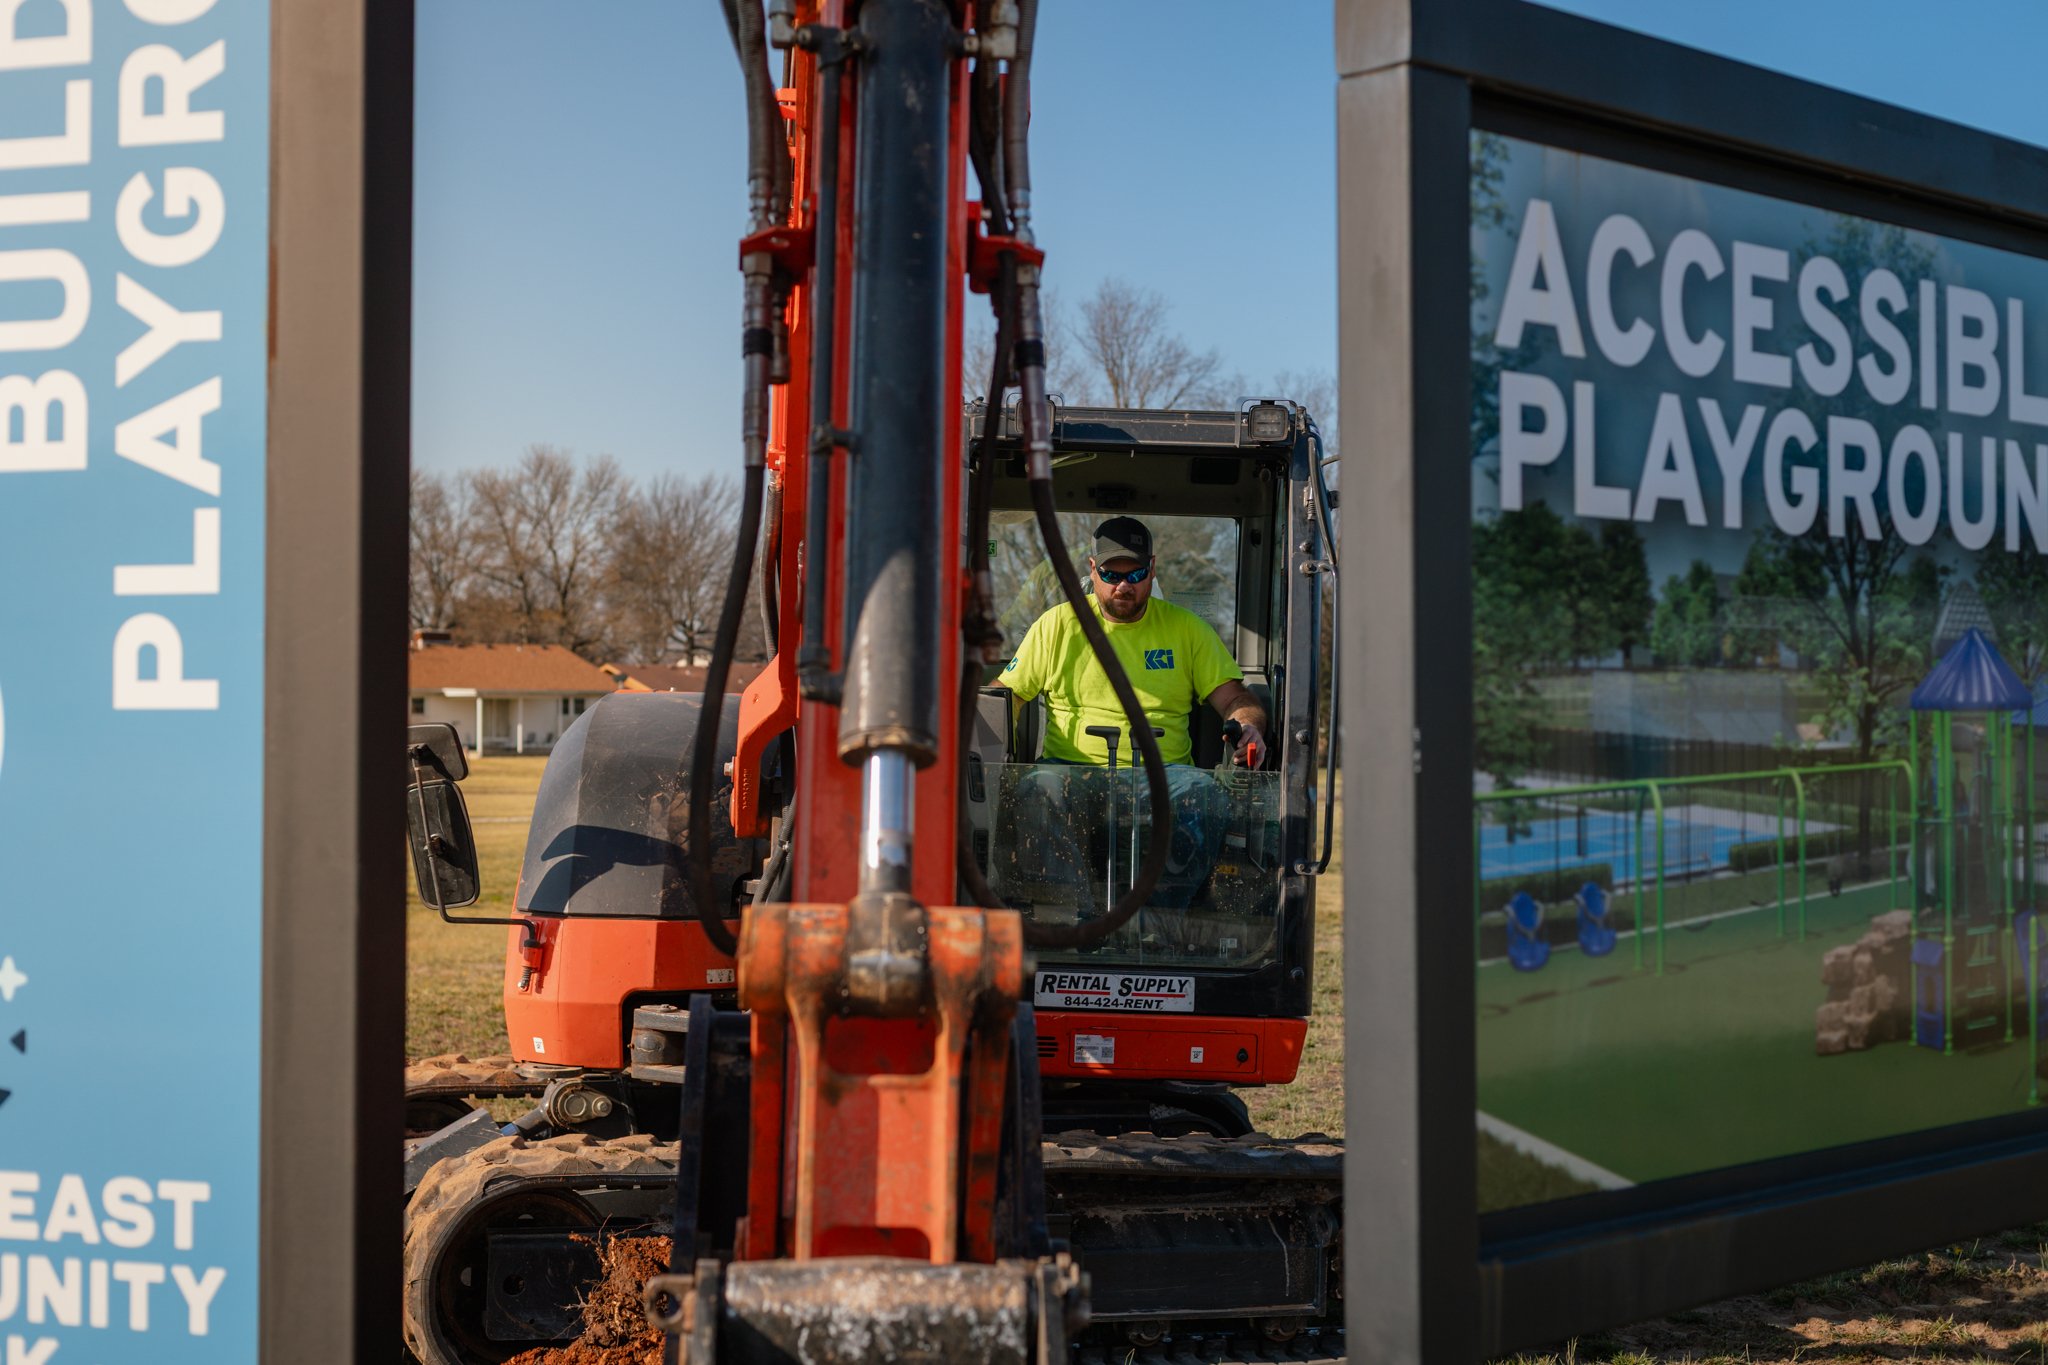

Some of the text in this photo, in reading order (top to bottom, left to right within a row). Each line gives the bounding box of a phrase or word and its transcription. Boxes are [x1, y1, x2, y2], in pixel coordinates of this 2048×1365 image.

[113, 0, 226, 710] PLAYGR
[1495, 198, 2048, 426] ACCESSIBL
[1500, 370, 2048, 556] PLAYGROUN
[1040, 974, 1190, 997] RENTAL SUPPLY
[1064, 996, 1165, 1010] 844-424-RENT
